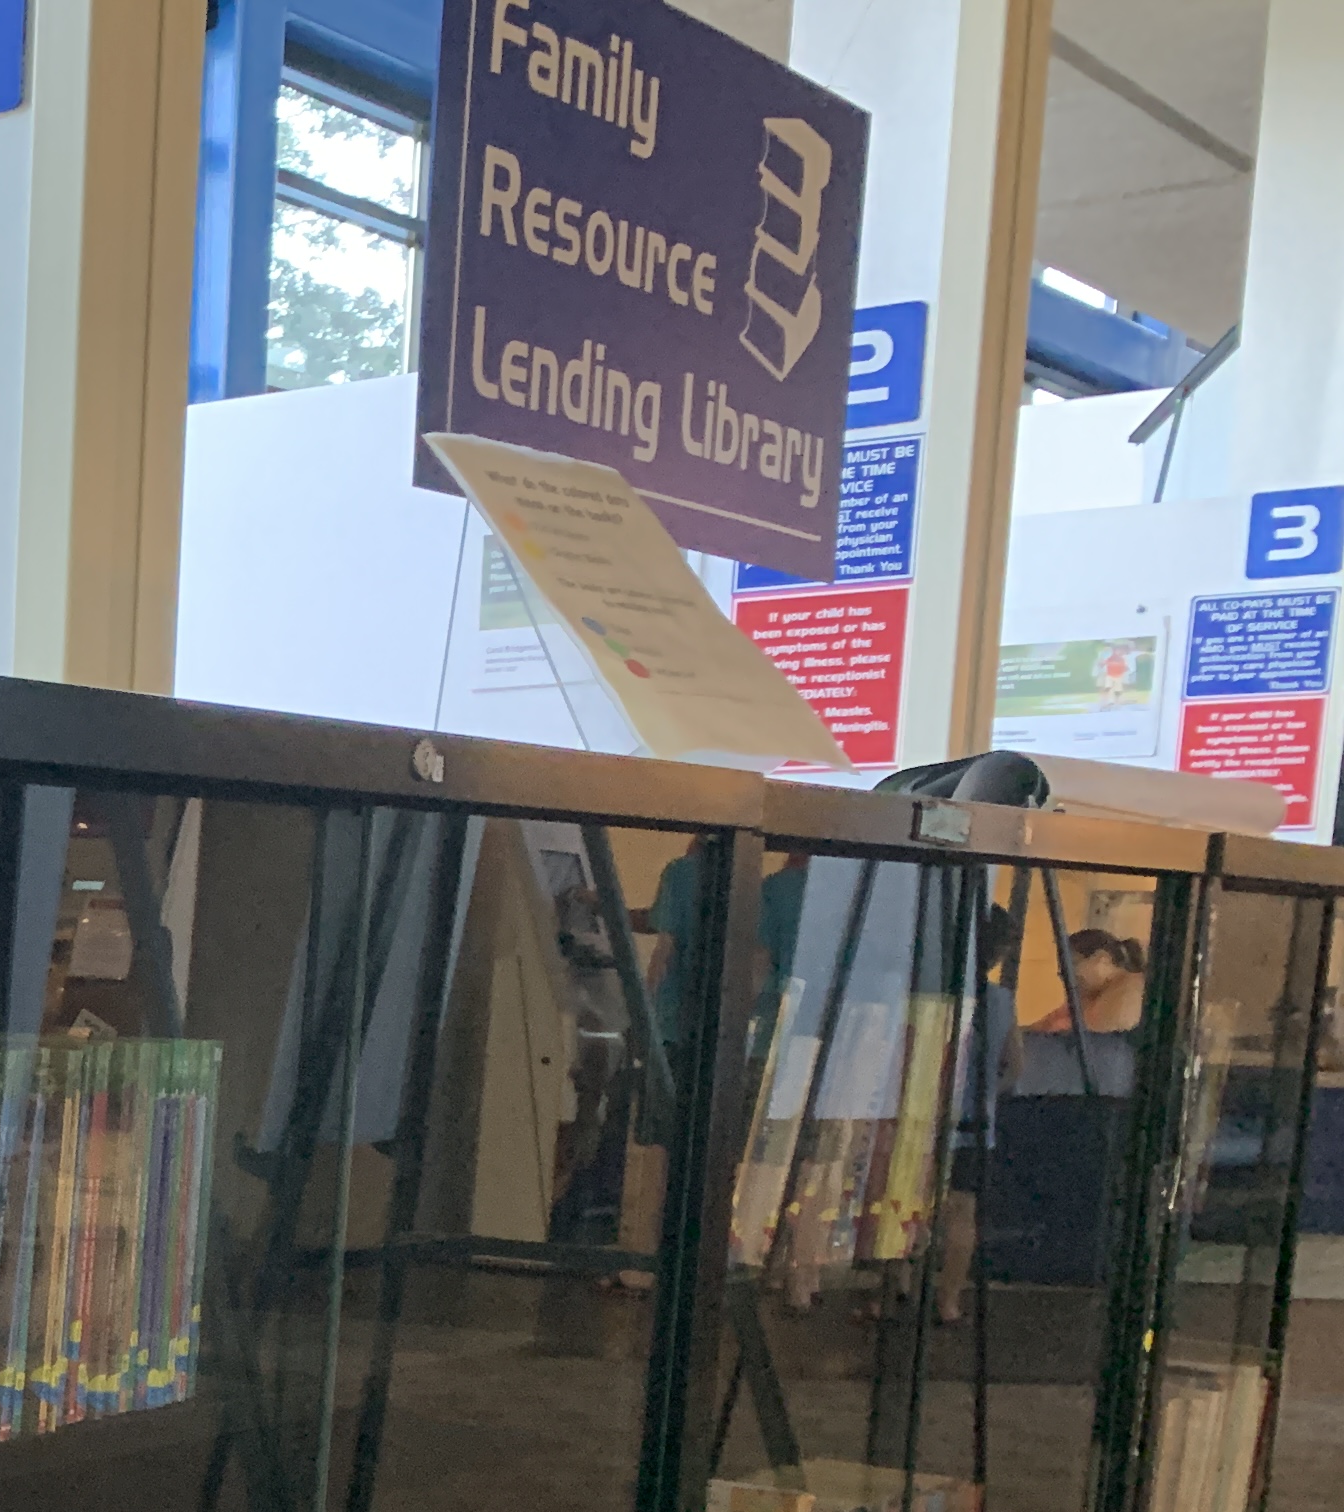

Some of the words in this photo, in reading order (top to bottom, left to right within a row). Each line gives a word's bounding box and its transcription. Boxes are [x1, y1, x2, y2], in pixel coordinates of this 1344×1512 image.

[489, 0, 661, 161] Family
[479, 144, 717, 315] Resource
[472, 305, 661, 464] Lending
[681, 372, 824, 509] Library
[847, 447, 890, 464] MUST
[895, 445, 915, 458] BE
[861, 462, 896, 477] TIME
[841, 480, 874, 494] VICE
[874, 493, 889, 504] of
[892, 493, 908, 503] an
[856, 507, 898, 520] receive
[838, 523, 866, 534] from
[870, 521, 898, 532] your
[1265, 504, 1321, 562] 3
[837, 533, 893, 548] physician
[839, 563, 875, 575] Thank
[880, 561, 902, 572] You
[1199, 602, 1219, 611] ALL
[1223, 599, 1273, 610] CO-PAYS
[1277, 596, 1312, 607] MUST
[782, 611, 812, 624] your
[815, 607, 844, 620] child
[848, 606, 872, 616] has
[1242, 610, 1258, 620] AT
[1262, 609, 1284, 618] THE
[753, 630, 782, 640] been
[786, 624, 839, 638] exposed
[843, 623, 858, 633] or
[862, 621, 886, 631] has
[1246, 619, 1299, 632] SERVICE
[764, 642, 827, 656] symptoms
[832, 639, 846, 650] of
[851, 638, 872, 648] the
[850, 654, 891, 667] please
[811, 669, 886, 684] receptionist
